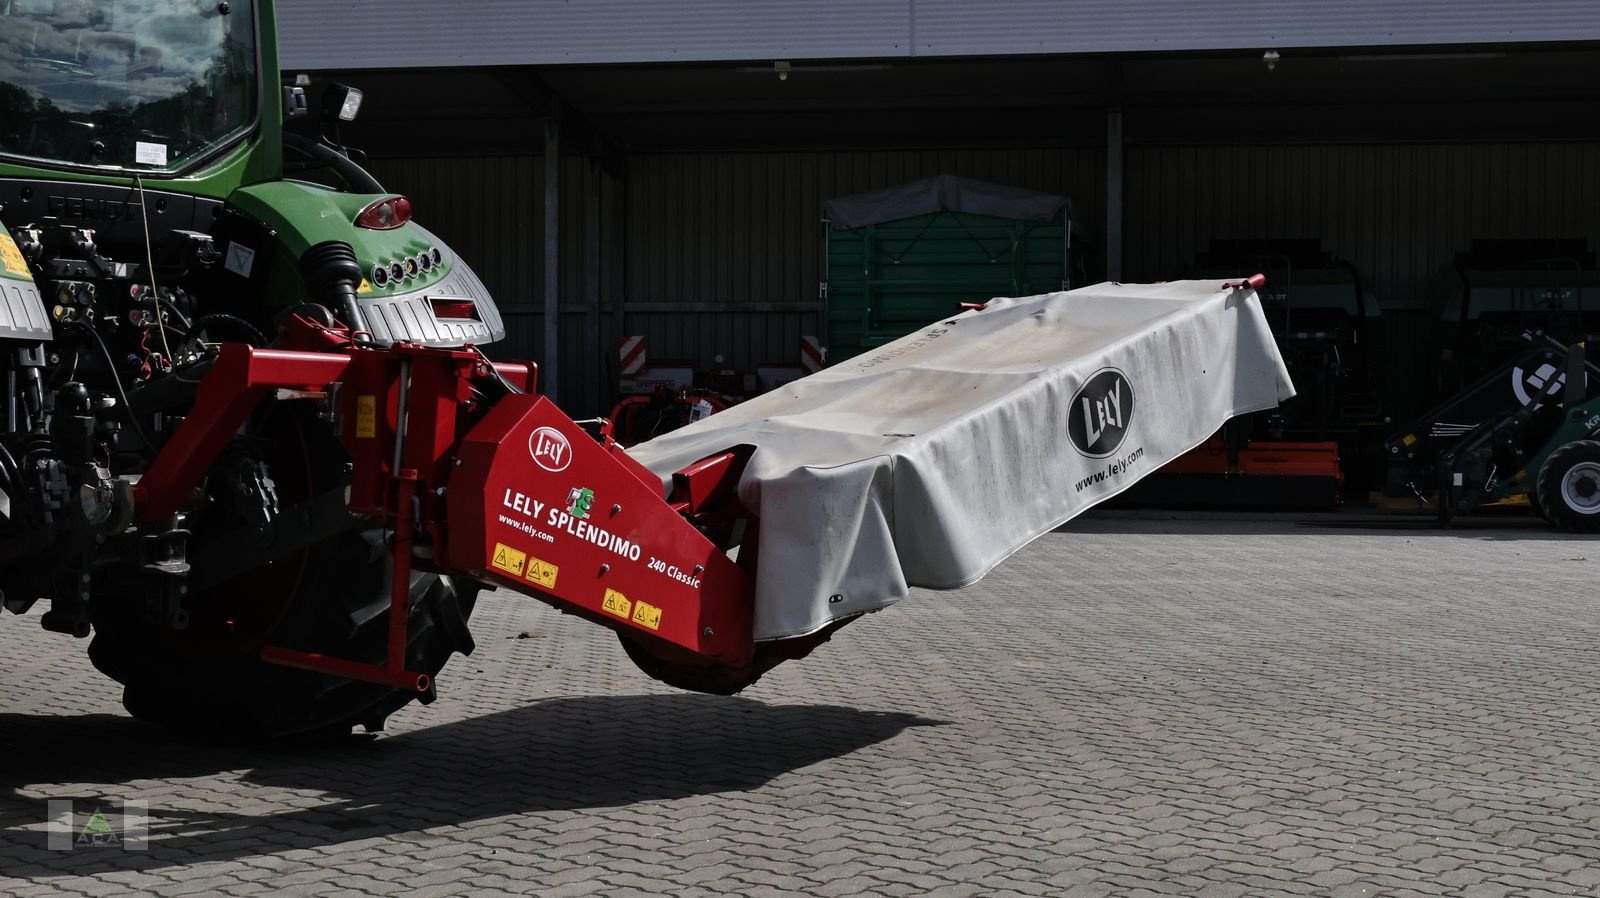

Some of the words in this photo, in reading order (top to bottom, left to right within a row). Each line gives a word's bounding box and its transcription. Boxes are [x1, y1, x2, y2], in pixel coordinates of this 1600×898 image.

[48, 196, 141, 222] FENDT
[1082, 377, 1122, 448] LELY
[535, 431, 566, 465] LELY
[1075, 446, 1144, 493] www.lely.com
[499, 514, 554, 543] www.lely.com
[503, 488, 545, 519] LELY
[547, 507, 641, 561] SPLENDIMO
[647, 556, 666, 573] 240
[667, 565, 700, 589] Classic
